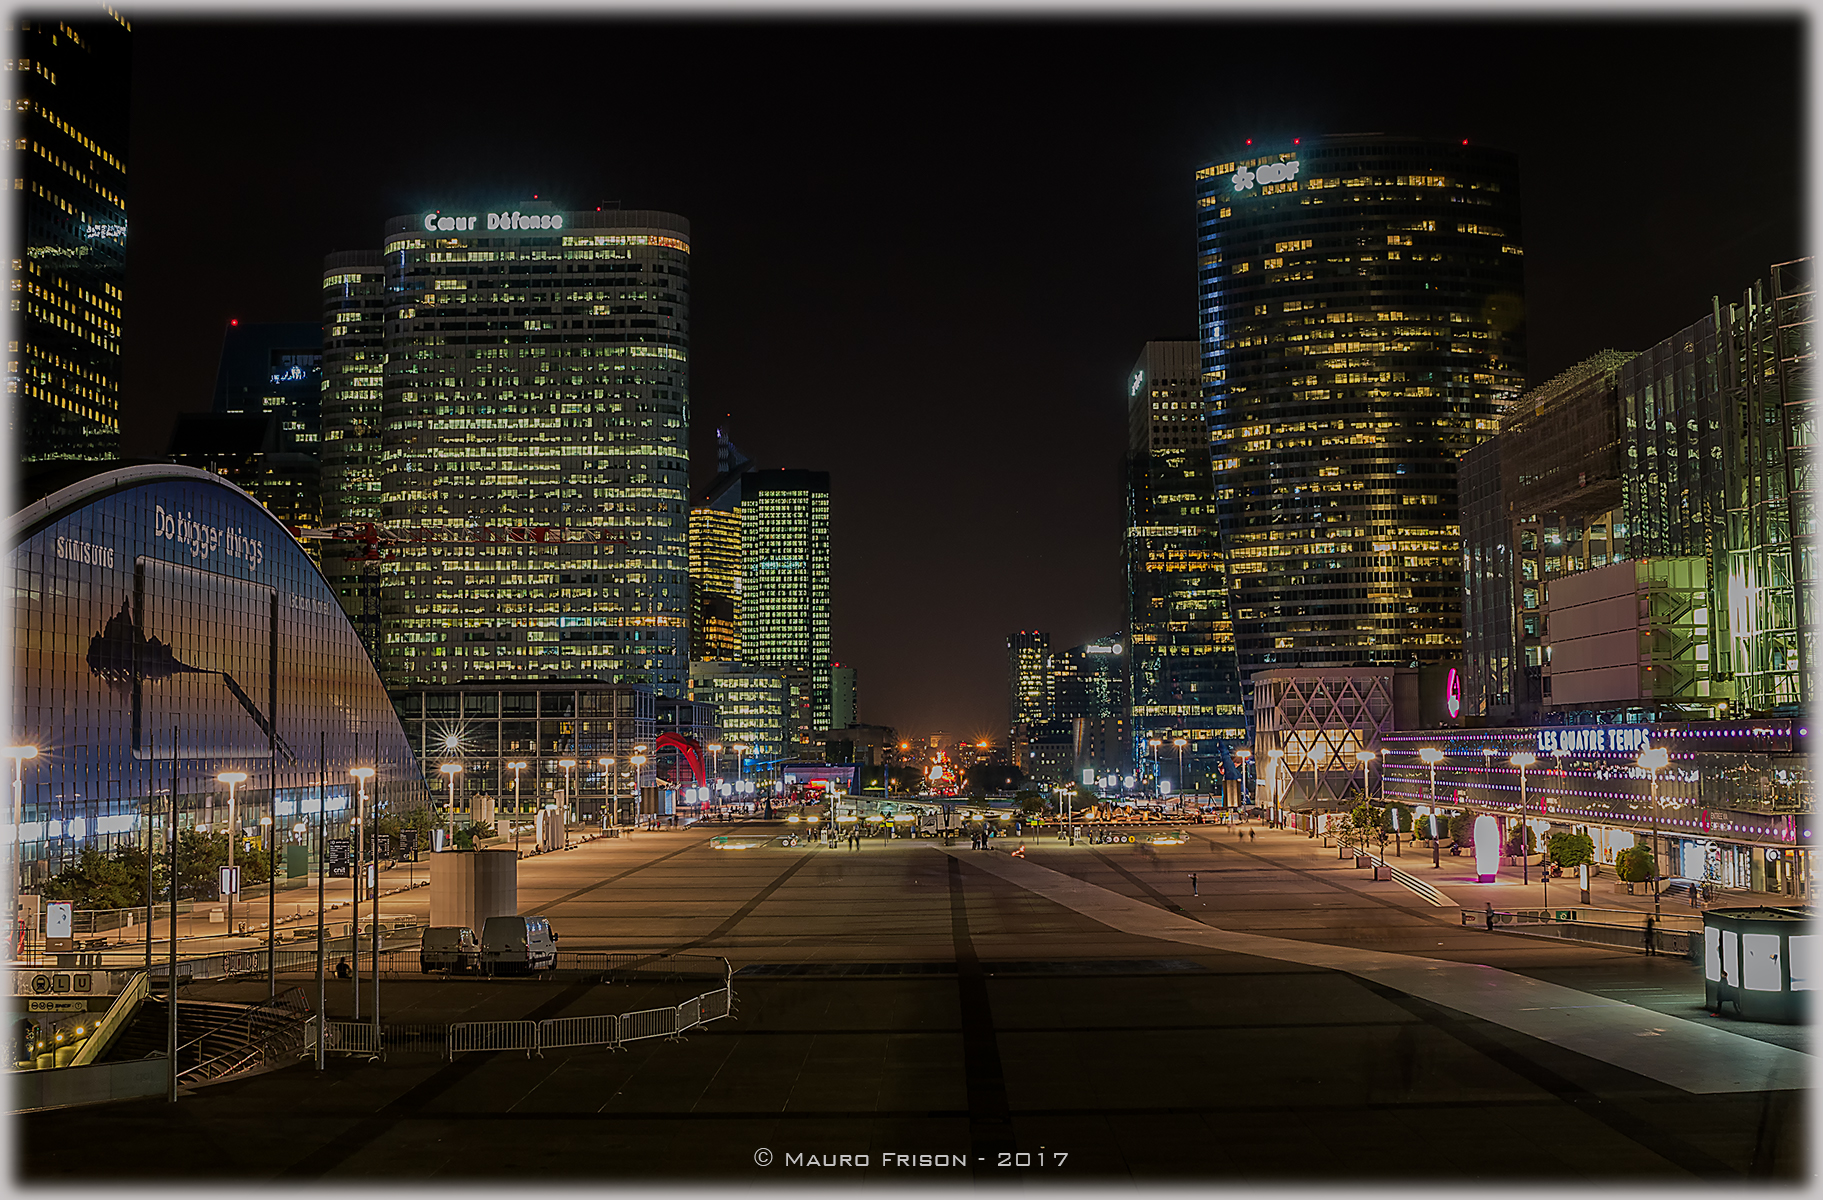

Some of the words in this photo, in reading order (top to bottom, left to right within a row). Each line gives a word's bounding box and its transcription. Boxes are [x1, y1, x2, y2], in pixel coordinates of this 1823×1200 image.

[487, 211, 563, 230] Défense
[155, 504, 175, 540] Do
[177, 511, 224, 560] bigger
[226, 526, 263, 572] things
[56, 536, 114, 569] SAMSUNG
[1538, 730, 1558, 751] LES
[1560, 729, 1605, 751] QUATRE
[1608, 728, 1650, 751] TEMPS
[78, 978, 86, 988] U
